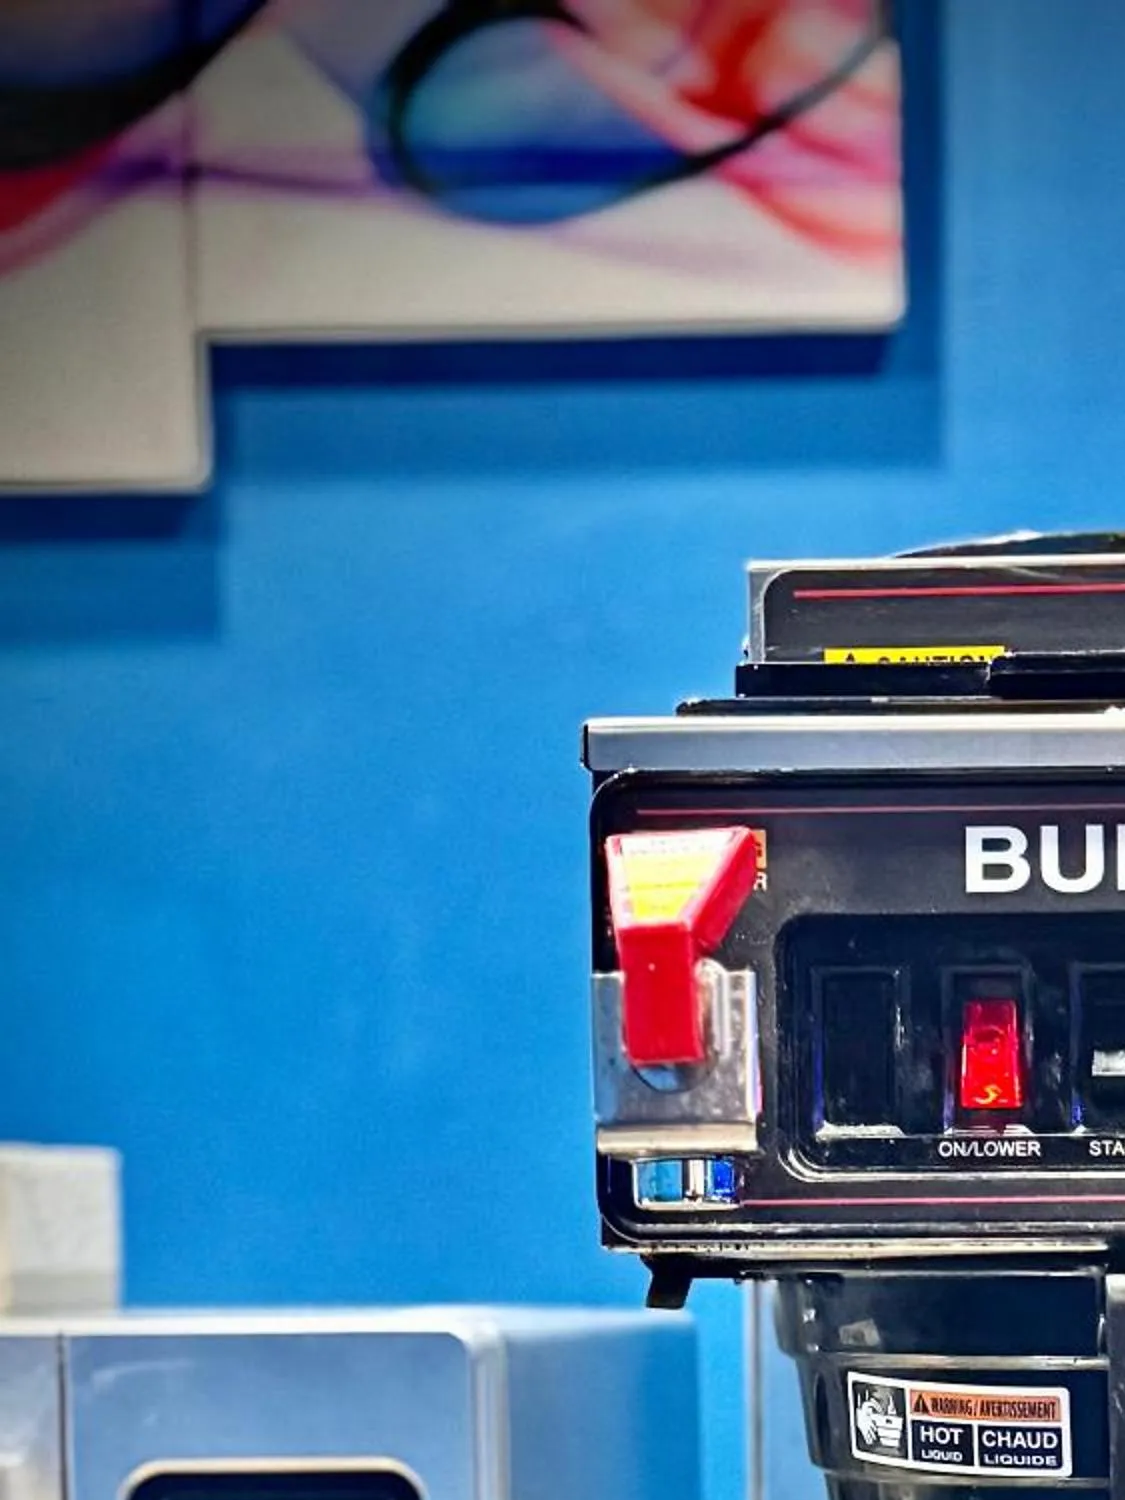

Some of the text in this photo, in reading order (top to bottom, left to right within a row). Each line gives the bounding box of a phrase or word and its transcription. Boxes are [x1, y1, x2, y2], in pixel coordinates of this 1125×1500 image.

[939, 1141, 1041, 1157] ON/LOWER
[920, 1425, 963, 1445] HOT
[982, 1430, 1058, 1449] CHAUD
[921, 1450, 963, 1462] LIQUID
[983, 1453, 1057, 1466] LIQUIDE
